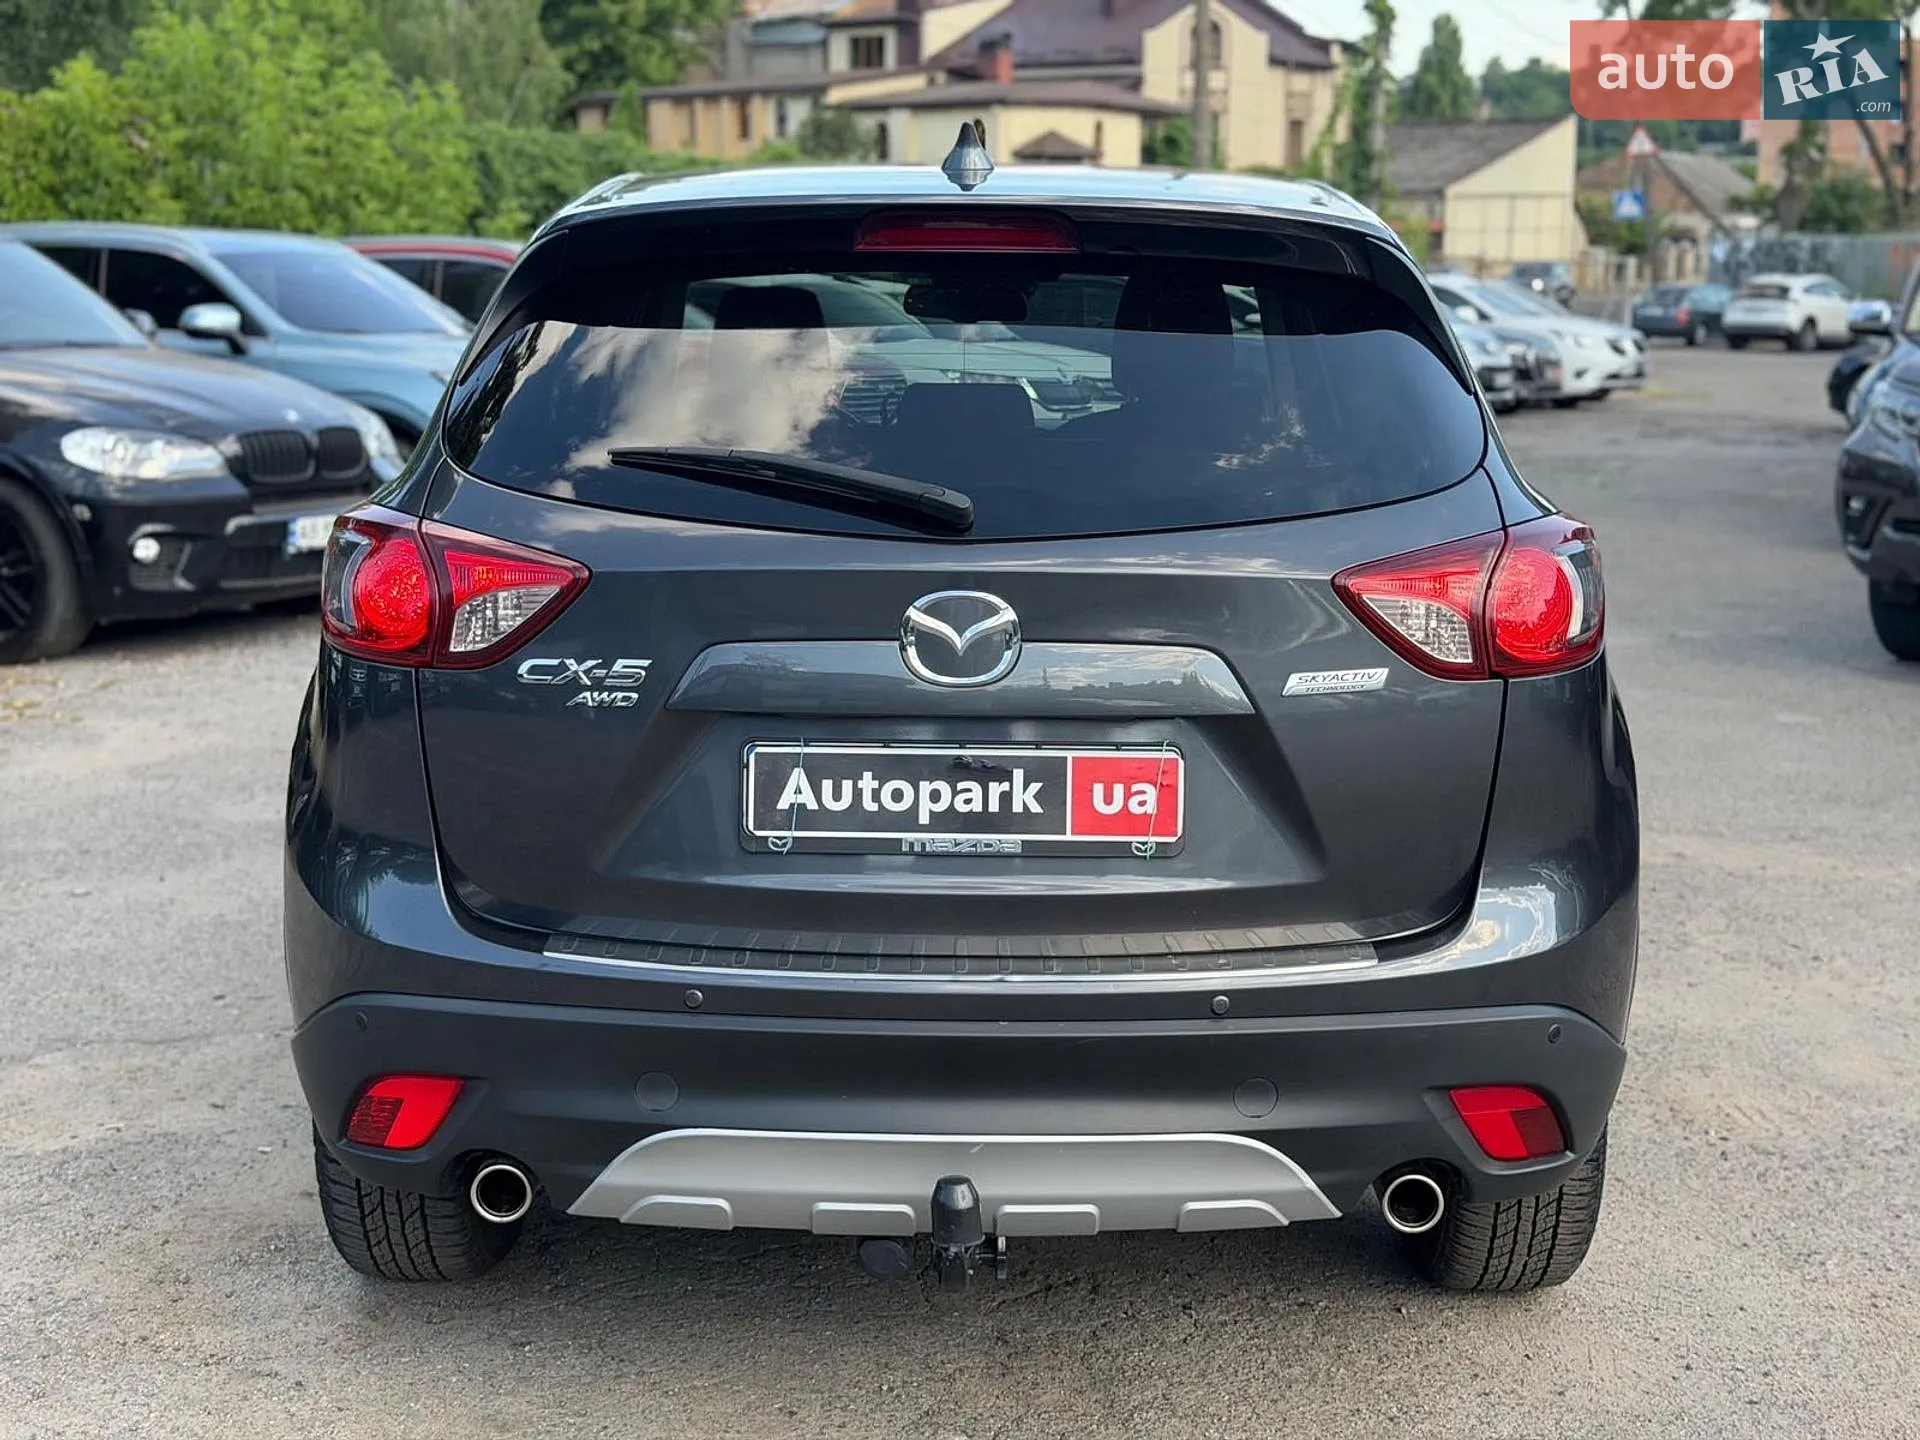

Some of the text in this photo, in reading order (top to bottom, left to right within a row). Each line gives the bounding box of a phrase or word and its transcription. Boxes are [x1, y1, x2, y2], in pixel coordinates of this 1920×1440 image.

[515, 658, 653, 687] CX-5
[1296, 671, 1379, 684] SKYACTIV
[1305, 684, 1368, 693] TECHNOLOGY
[565, 691, 639, 708] AWD
[776, 767, 1158, 825] Autopark ua
